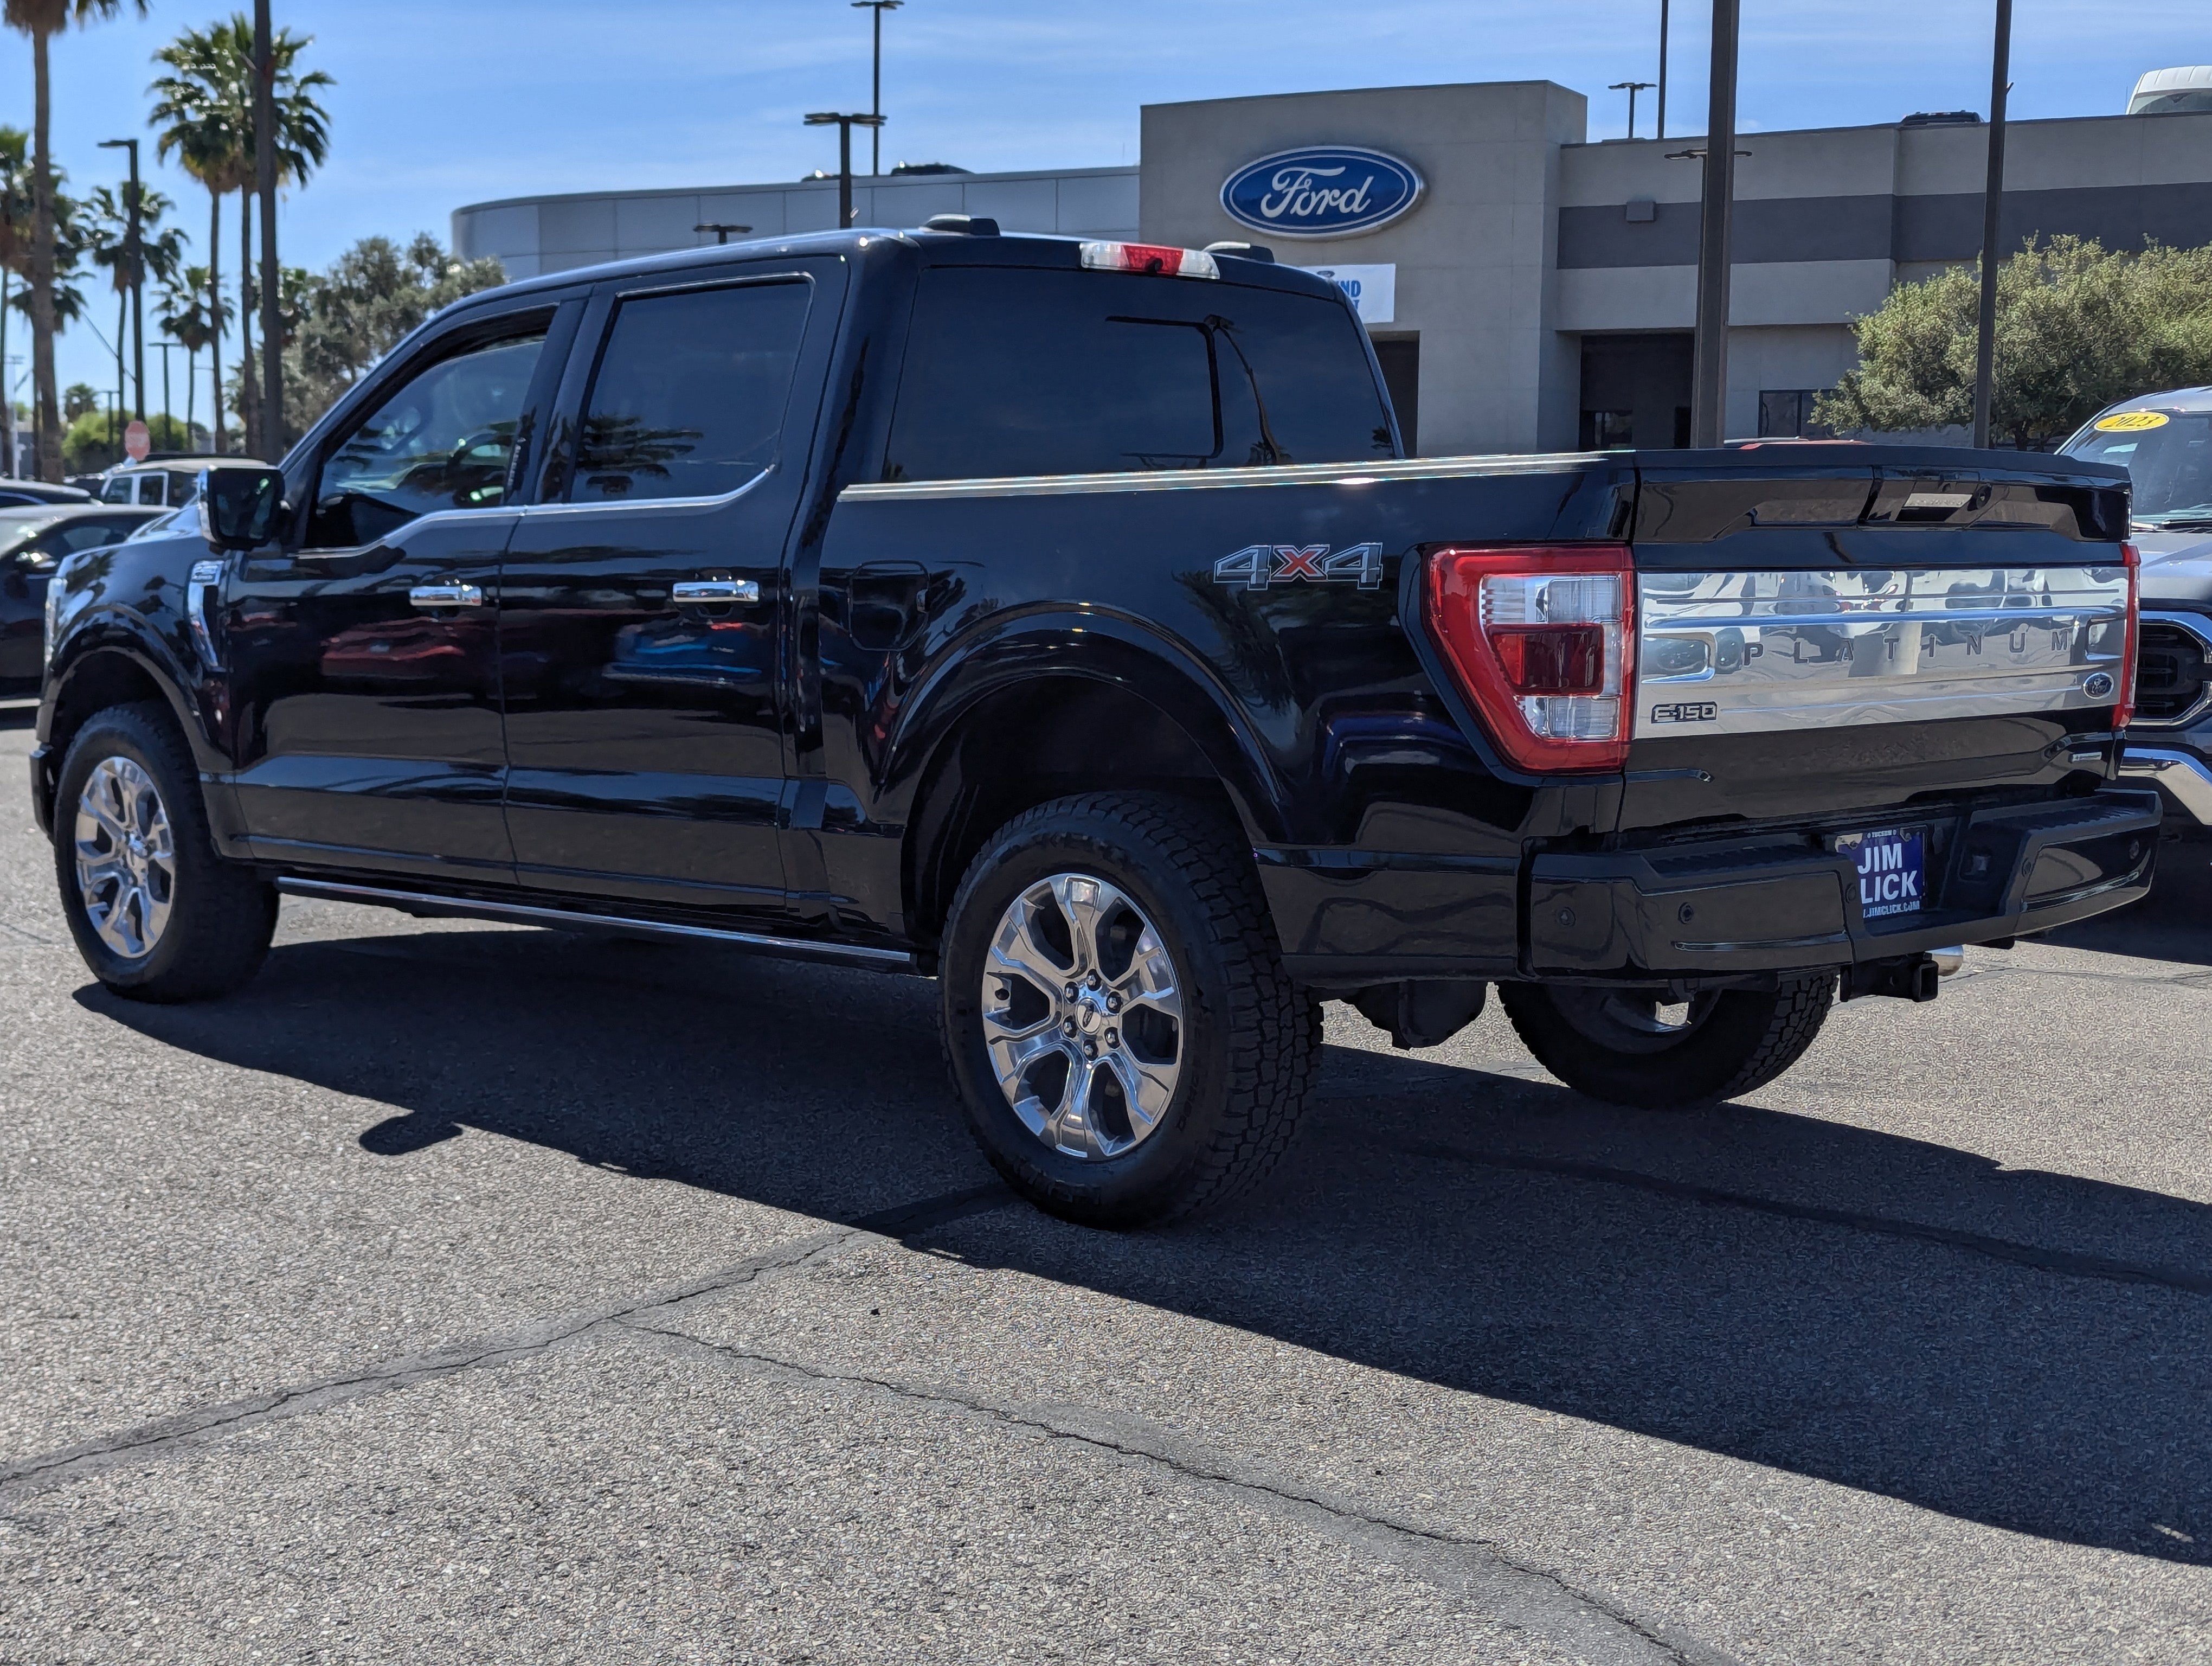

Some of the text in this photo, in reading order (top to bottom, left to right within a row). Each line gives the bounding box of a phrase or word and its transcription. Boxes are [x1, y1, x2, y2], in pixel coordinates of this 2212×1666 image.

[1261, 166, 1374, 218] Ford
[1744, 631, 2069, 667] PLATINUM
[1651, 701, 1718, 723] F-150
[1857, 843, 1902, 874] JIM
[1860, 870, 1918, 904] LICK
